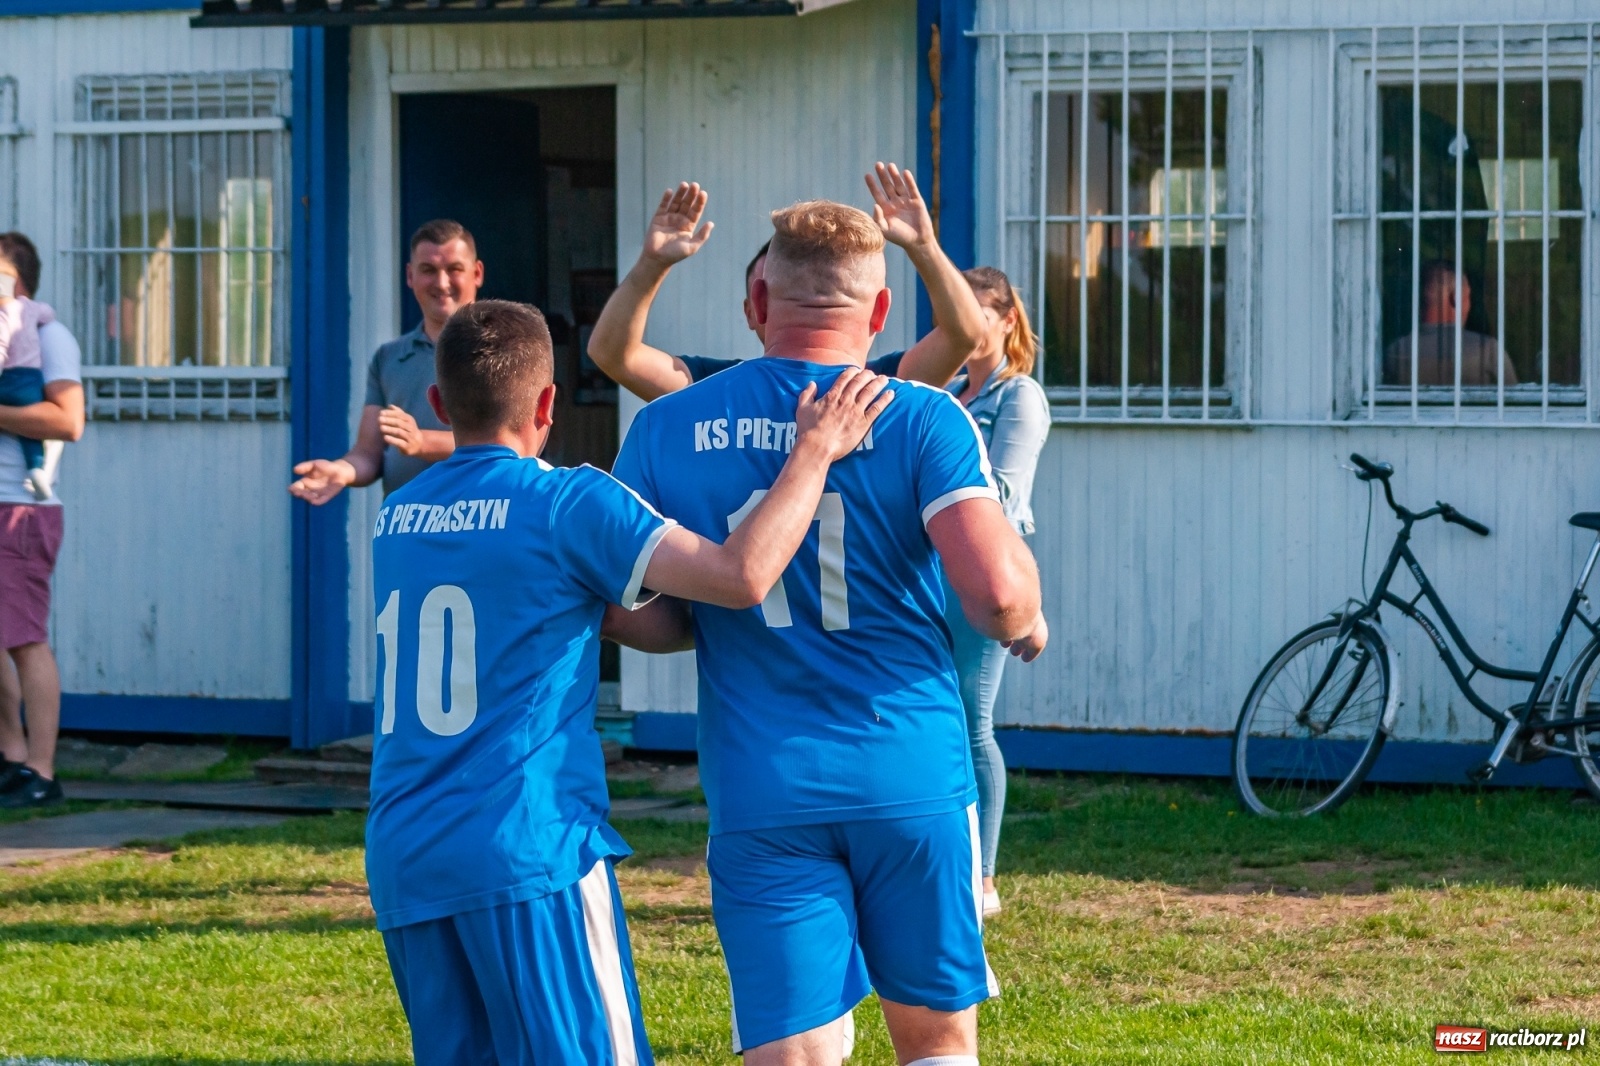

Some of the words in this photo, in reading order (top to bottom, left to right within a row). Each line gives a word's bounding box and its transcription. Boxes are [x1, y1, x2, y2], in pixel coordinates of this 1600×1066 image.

[694, 418, 730, 452] KS
[388, 499, 510, 535] PIETRASZYN
[376, 584, 478, 737] 10
